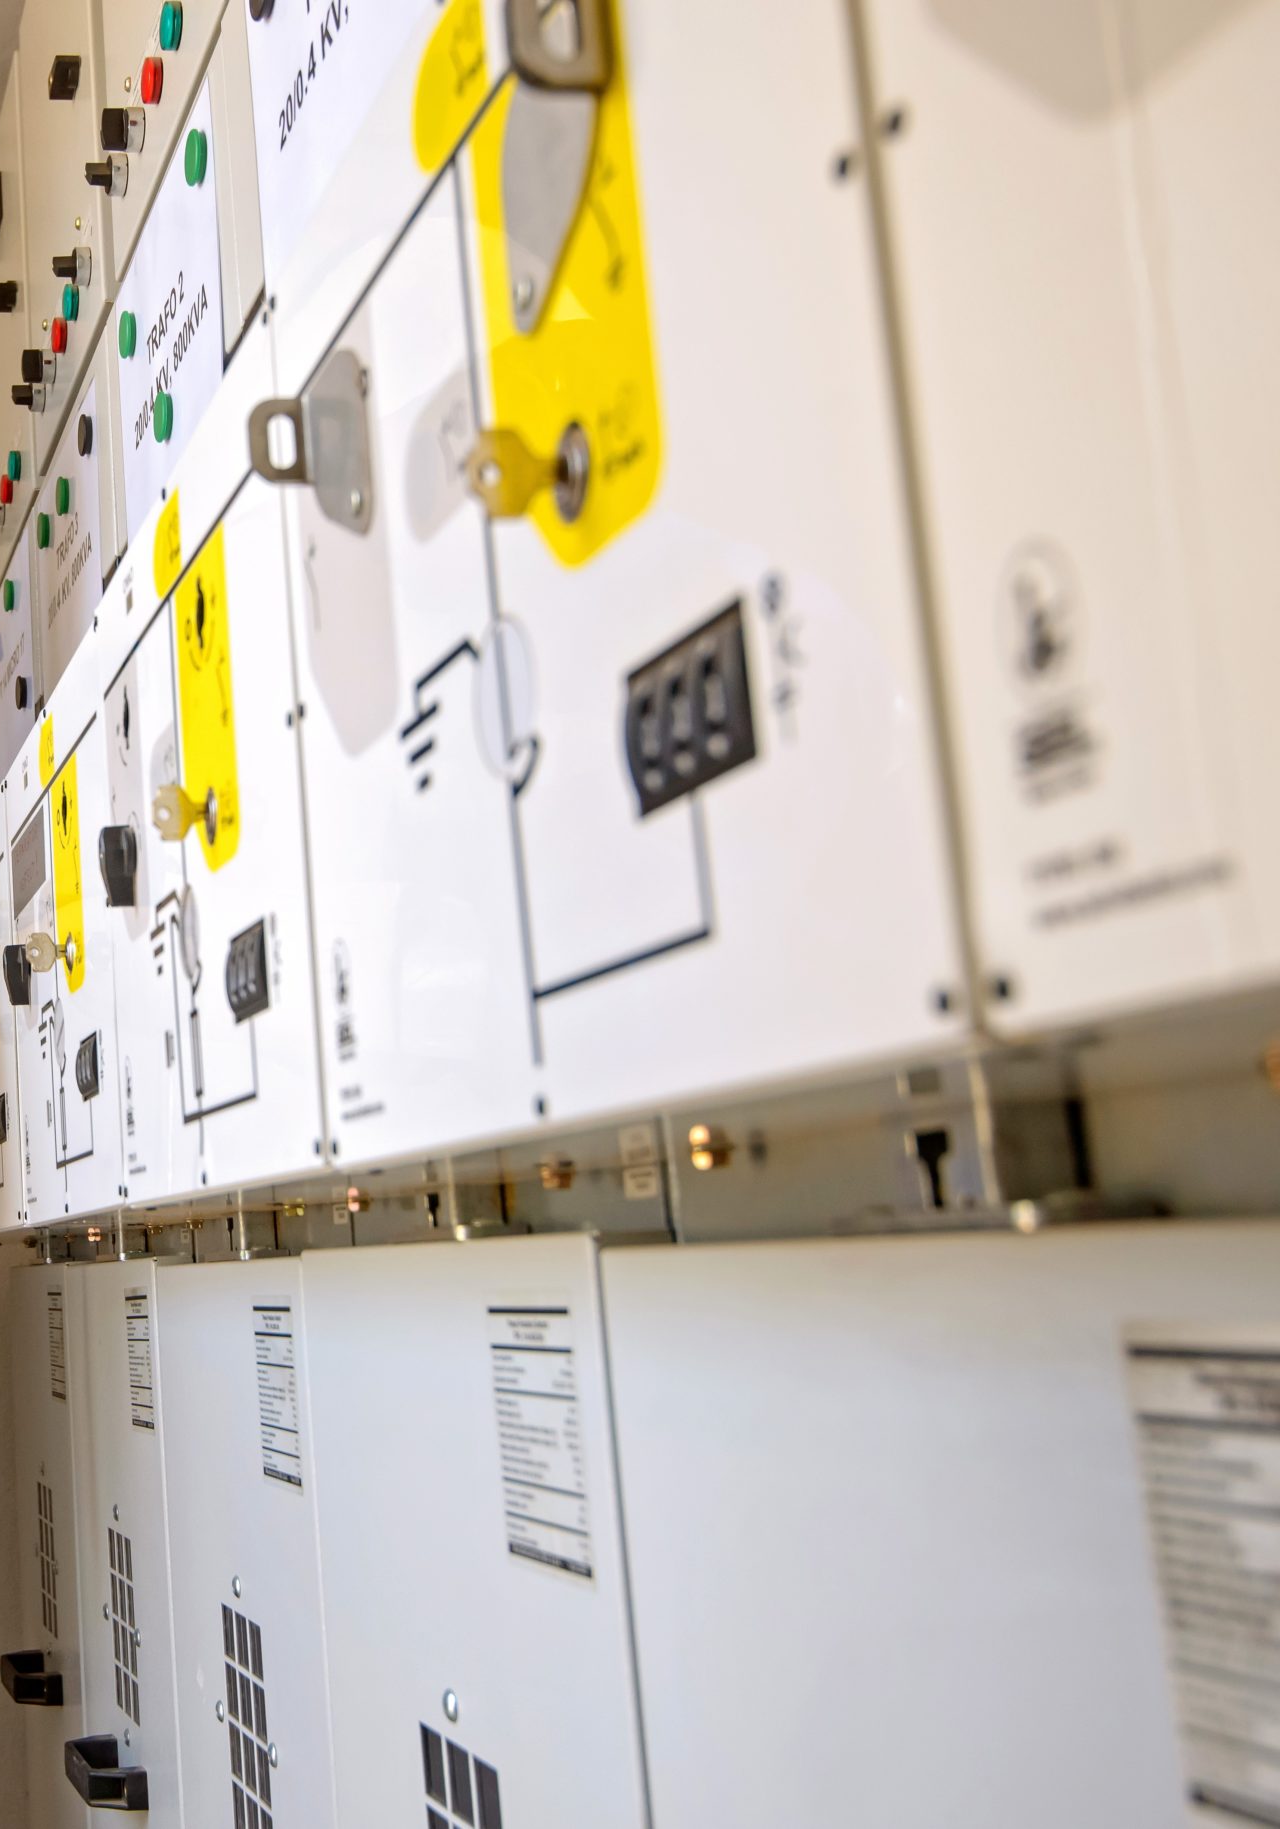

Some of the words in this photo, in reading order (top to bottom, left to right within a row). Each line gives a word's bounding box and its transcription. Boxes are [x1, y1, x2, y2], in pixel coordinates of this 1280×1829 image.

[278, 41, 317, 152] 20/0.4
[146, 287, 177, 364] TRAFO
[177, 270, 184, 304] 2
[173, 283, 208, 373] 800KVA
[55, 524, 74, 571] TRAFO
